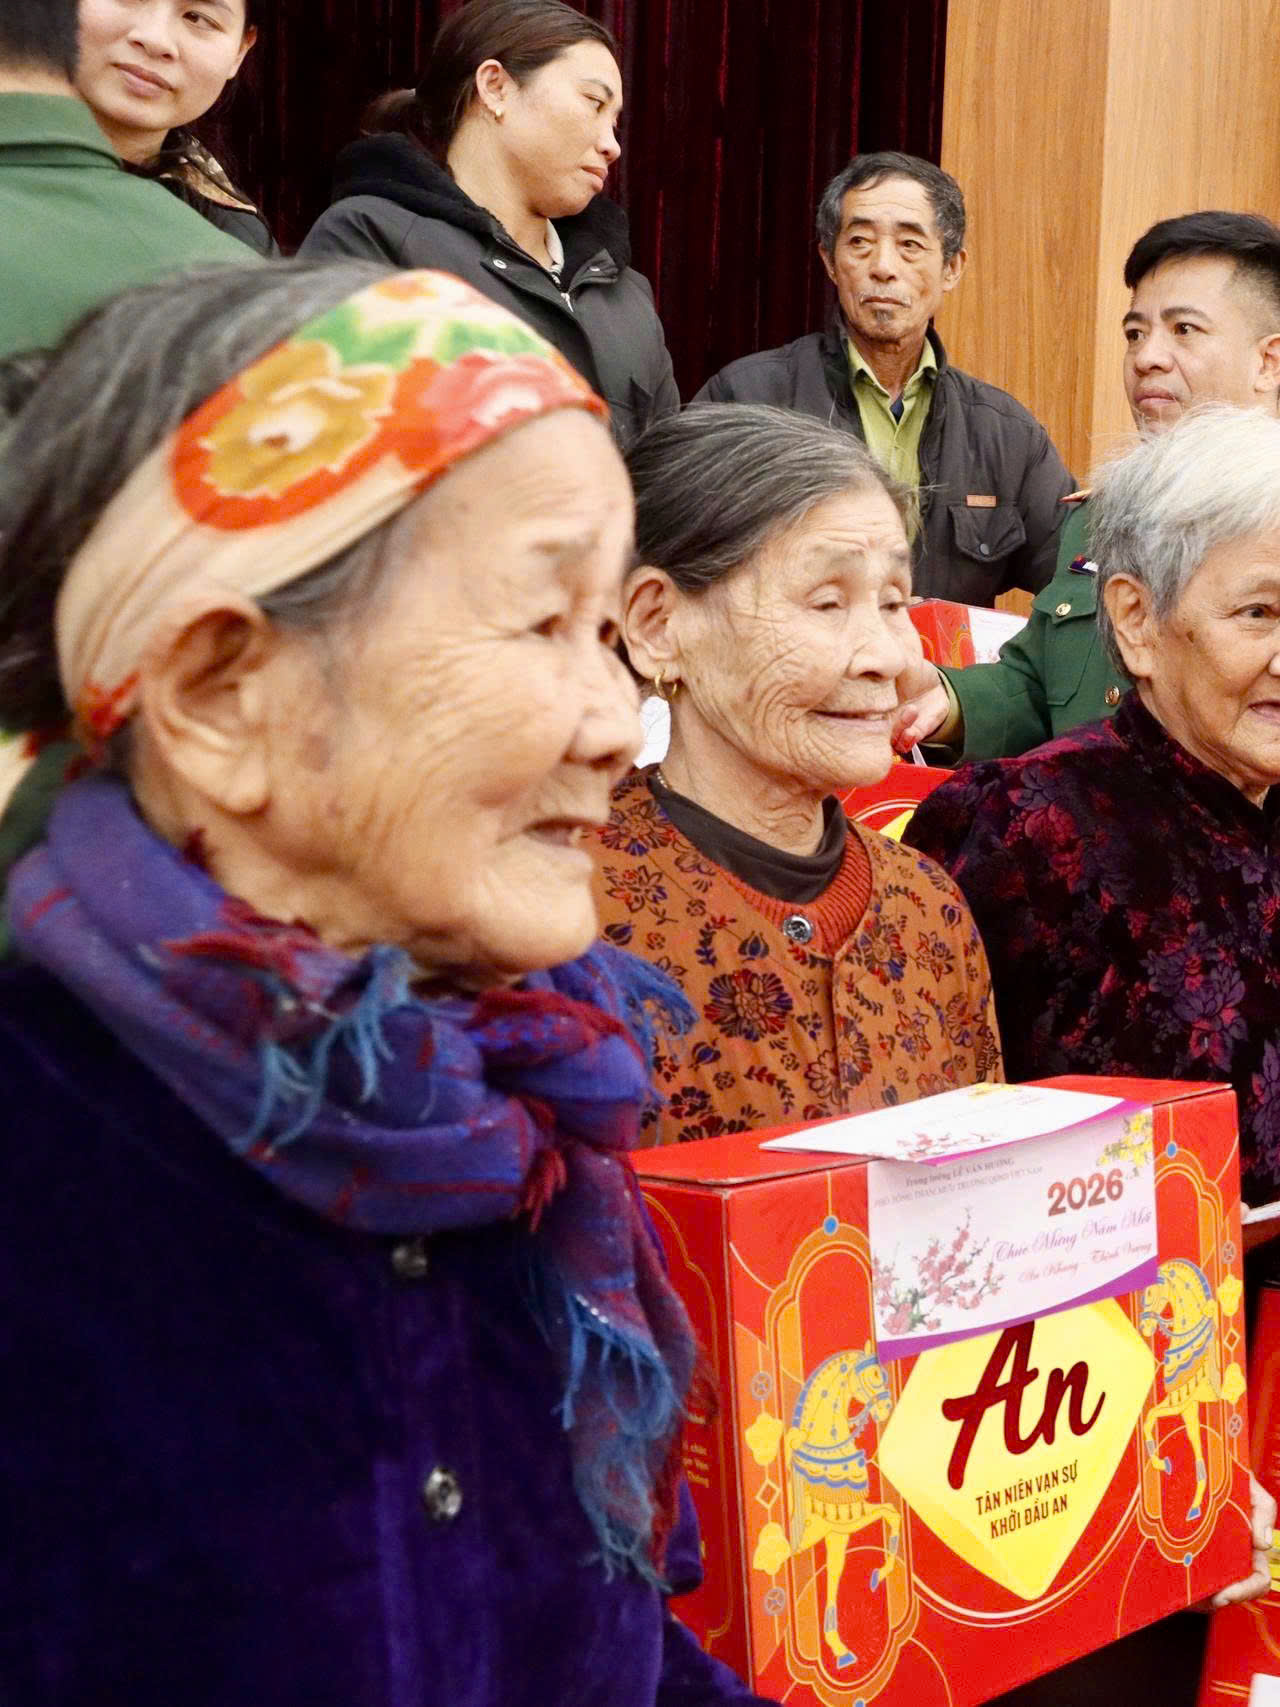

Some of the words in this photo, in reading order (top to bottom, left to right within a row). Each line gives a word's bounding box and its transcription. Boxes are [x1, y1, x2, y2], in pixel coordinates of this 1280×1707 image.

[1047, 1168, 1123, 1217] 2026
[942, 1320, 1106, 1490] An
[975, 1490, 1001, 1515] TÂN
[1004, 1478, 1033, 1505] NIÊN
[1035, 1469, 1059, 1493] VẠN
[1062, 1459, 1078, 1483] SỰ
[991, 1509, 1021, 1539] KHỞI
[1024, 1498, 1049, 1526] ĐẦU
[1053, 1494, 1068, 1516] AN
